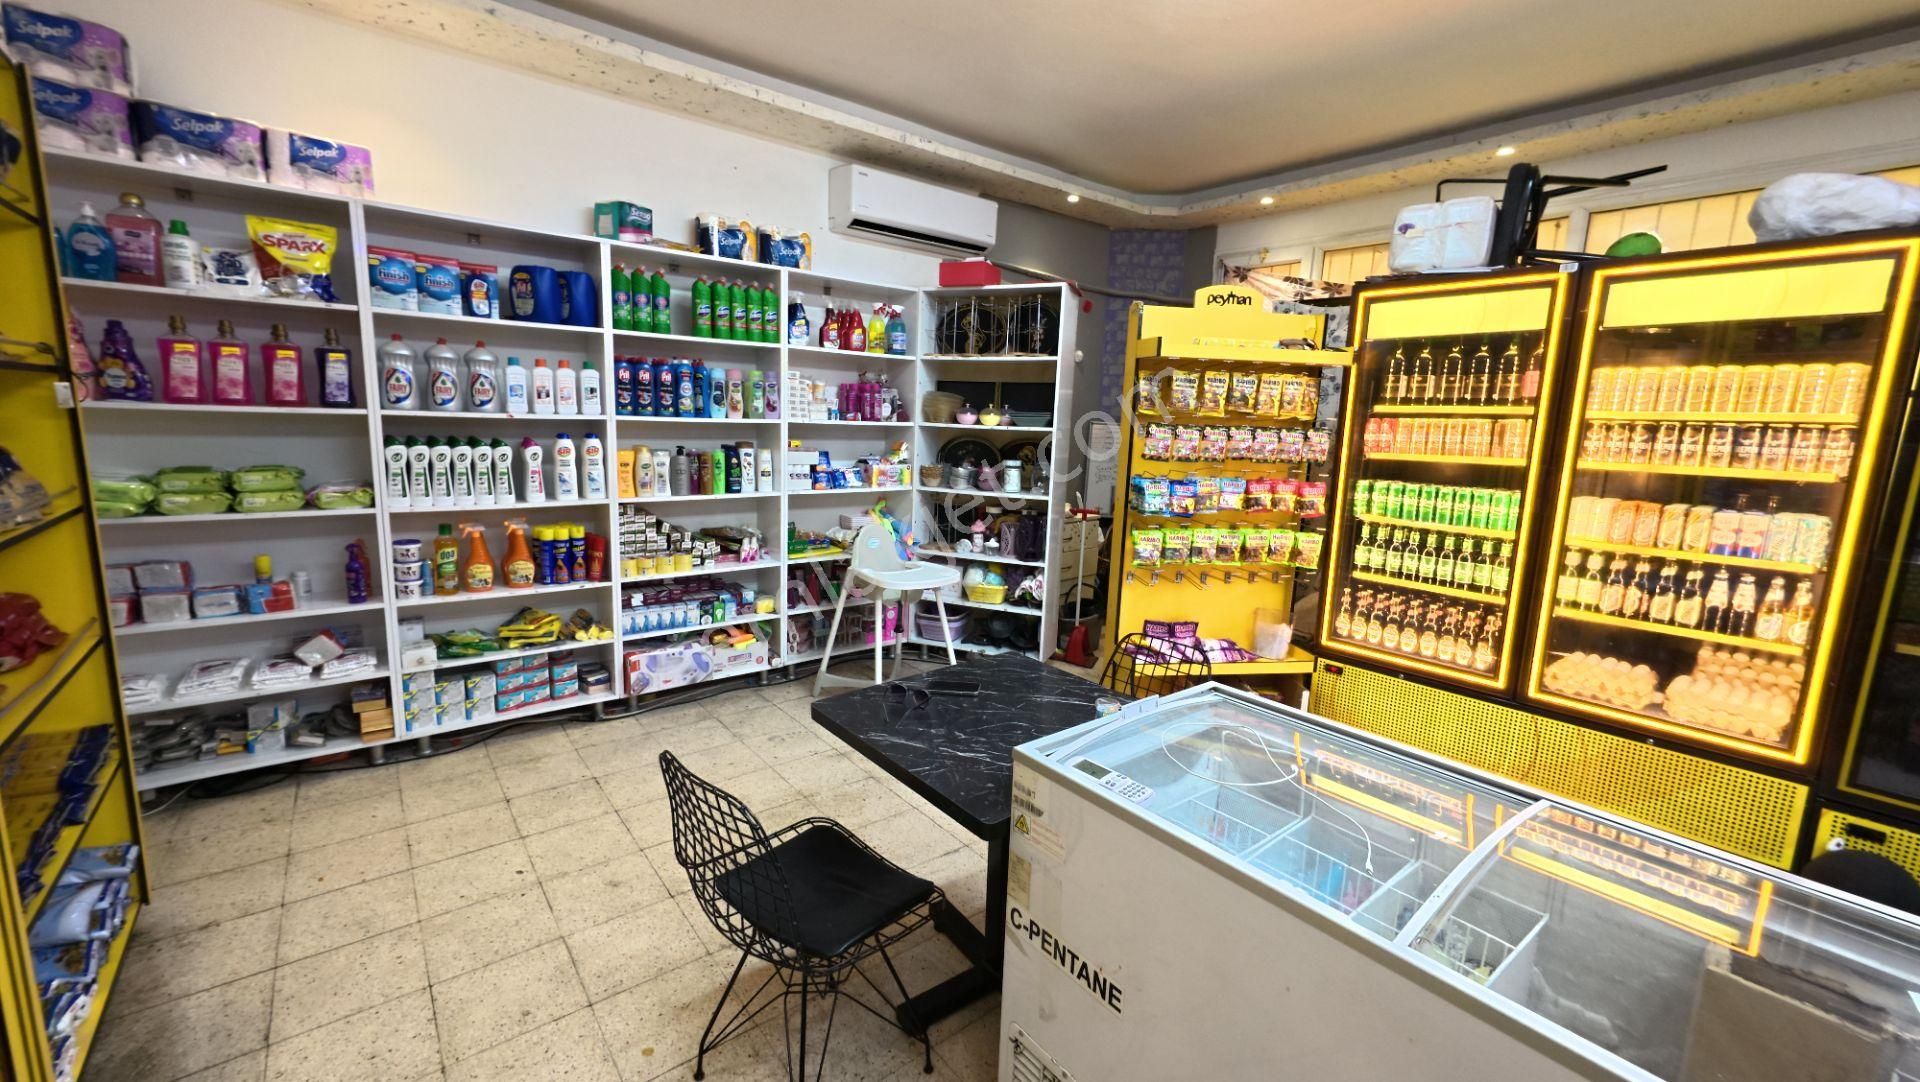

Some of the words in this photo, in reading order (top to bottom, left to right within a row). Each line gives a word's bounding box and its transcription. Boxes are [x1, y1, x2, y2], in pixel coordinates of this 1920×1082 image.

[15, 20, 73, 39] Selpak
[170, 117, 224, 134] Selpak
[298, 146, 339, 158] Selpak
[262, 233, 327, 254] SPARX
[720, 237, 742, 246] Selpak
[779, 246, 802, 257] Selpak
[378, 267, 409, 281] finish
[424, 275, 454, 288] finish
[1207, 292, 1252, 307] peyman
[618, 368, 630, 380] Pril
[638, 369, 650, 380] Pril
[661, 371, 672, 382] Pril
[1175, 376, 1196, 385] HARIBO
[1207, 376, 1226, 384] HARIBO
[389, 383, 407, 393] FAIRY
[435, 386, 453, 396] FAIRY
[474, 387, 491, 397] FAIRY
[1150, 427, 1171, 436] HARIBO
[1178, 428, 1200, 437] HARIBO
[557, 448, 571, 456] SIR
[586, 447, 600, 455] SIR
[1145, 483, 1167, 491] HARIBO
[1140, 536, 1161, 544] HARIBO
[1168, 534, 1190, 543] HARIBO
[1010, 907, 1122, 1014] C-PENTANE
